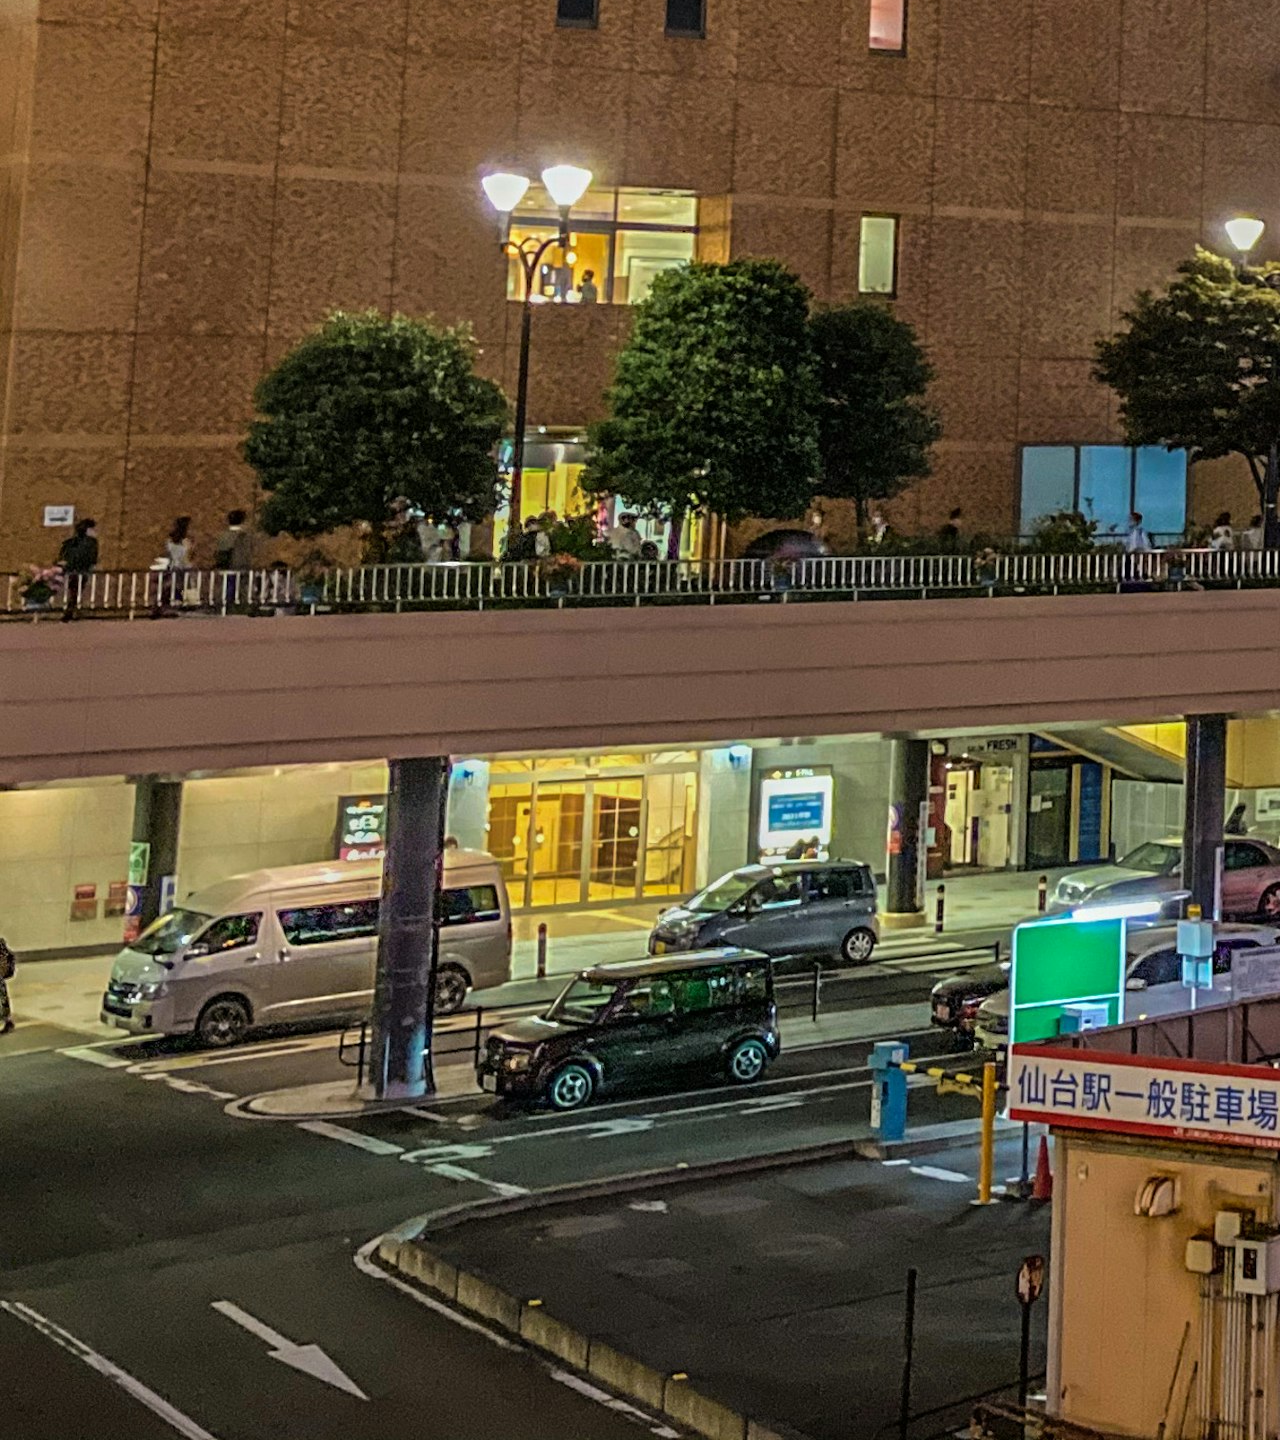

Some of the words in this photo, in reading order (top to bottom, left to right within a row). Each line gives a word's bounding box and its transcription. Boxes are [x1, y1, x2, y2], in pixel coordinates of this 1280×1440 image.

[987, 738, 1017, 751] FRESH
[1018, 1064, 1280, 1133] 仙台駅一般駐車場
